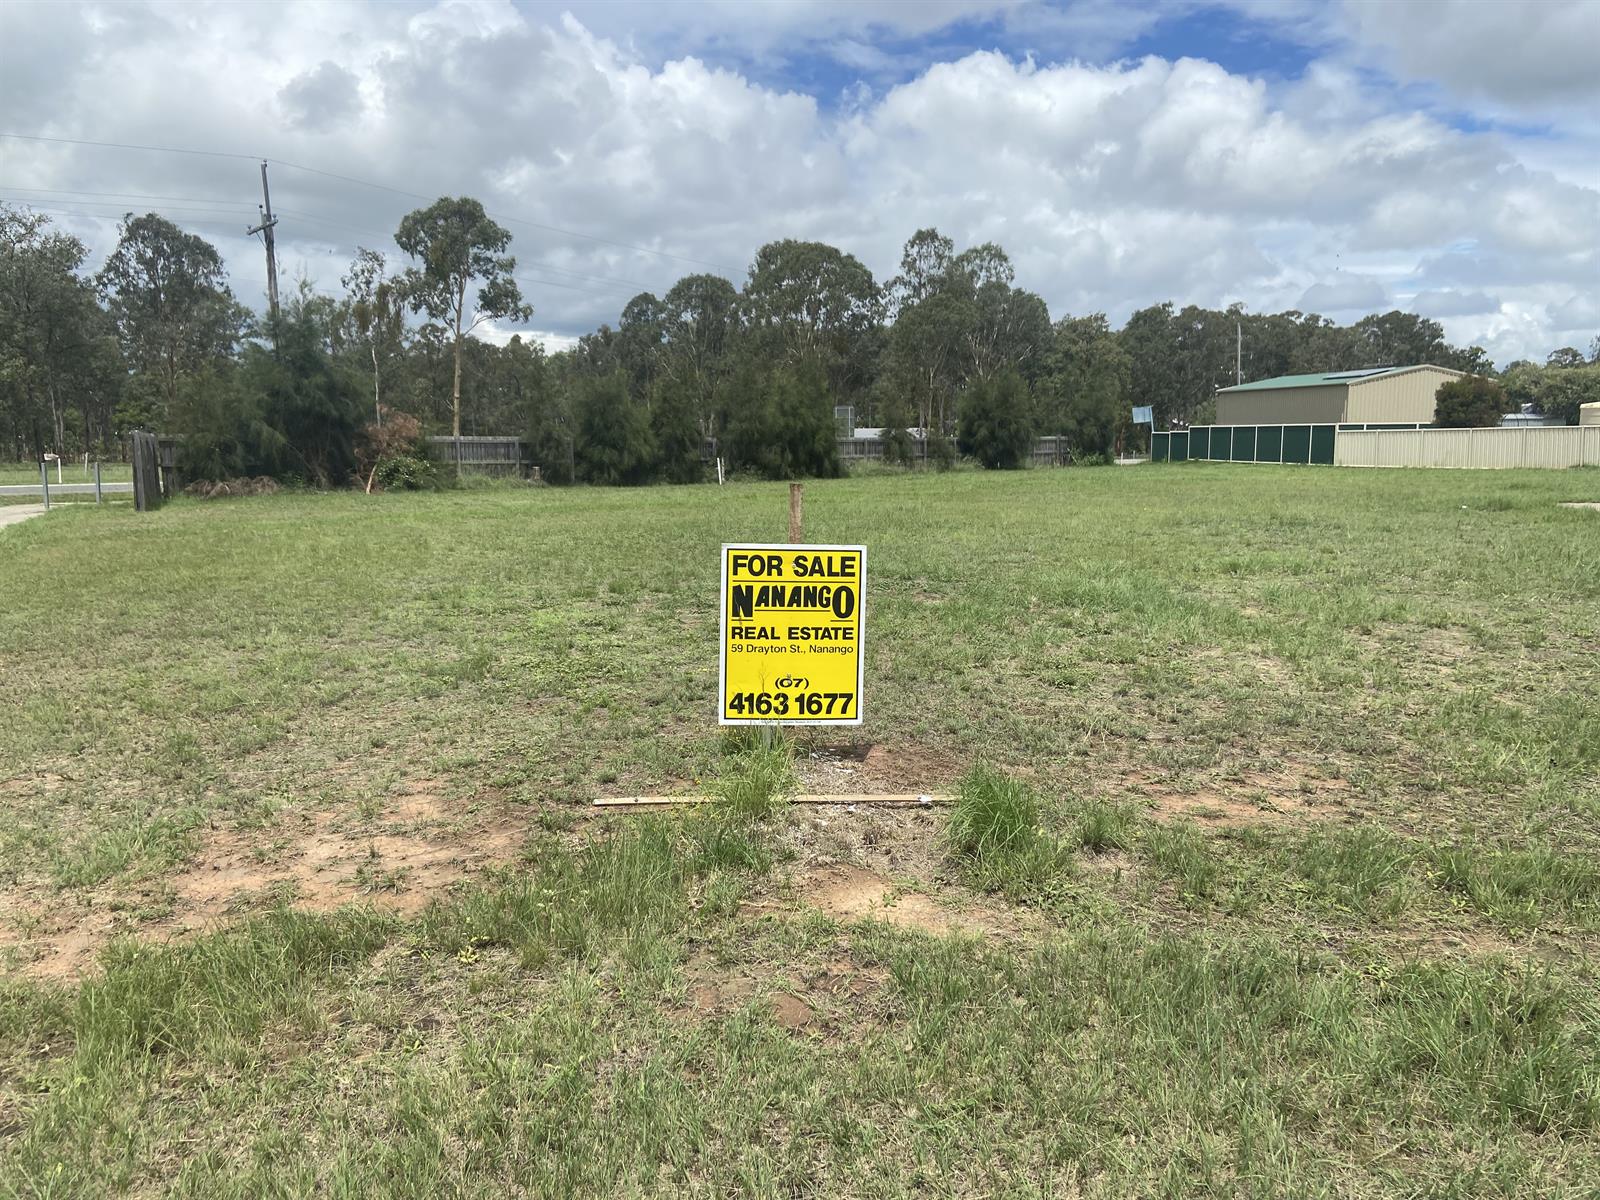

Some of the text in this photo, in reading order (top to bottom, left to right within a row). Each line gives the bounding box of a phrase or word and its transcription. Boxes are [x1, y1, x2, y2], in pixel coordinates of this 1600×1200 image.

[733, 555, 856, 577] FOR SALE
[731, 584, 855, 619] NANANGO
[731, 626, 854, 640] REAL ESTATE
[731, 644, 743, 653] 59
[746, 644, 787, 655] Drayton
[809, 645, 854, 656] Nanango
[775, 677, 809, 690] (07)
[729, 692, 854, 715] 4163 1677
